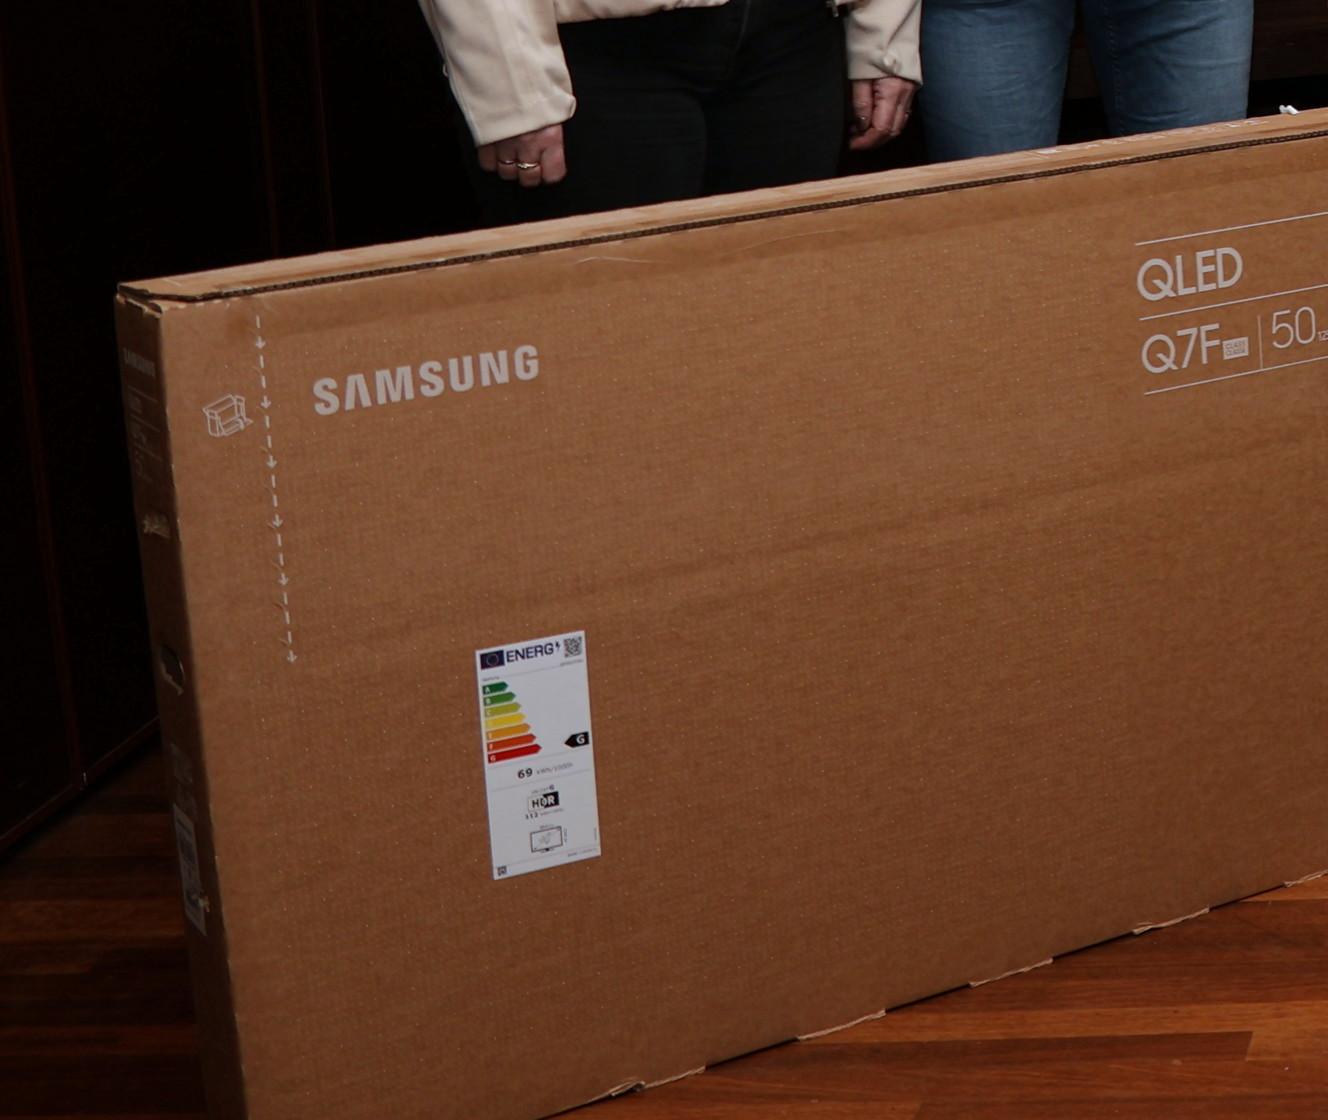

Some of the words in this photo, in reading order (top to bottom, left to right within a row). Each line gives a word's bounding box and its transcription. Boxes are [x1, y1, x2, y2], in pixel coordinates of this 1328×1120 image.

[1136, 246, 1244, 301] QLED
[1141, 322, 1221, 374] Q7F
[1271, 306, 1316, 349] 50
[312, 344, 541, 416] SAMSUNG
[506, 642, 554, 663] ENERG
[576, 734, 586, 745] G
[517, 767, 533, 779] 69
[531, 794, 556, 809] HDR
